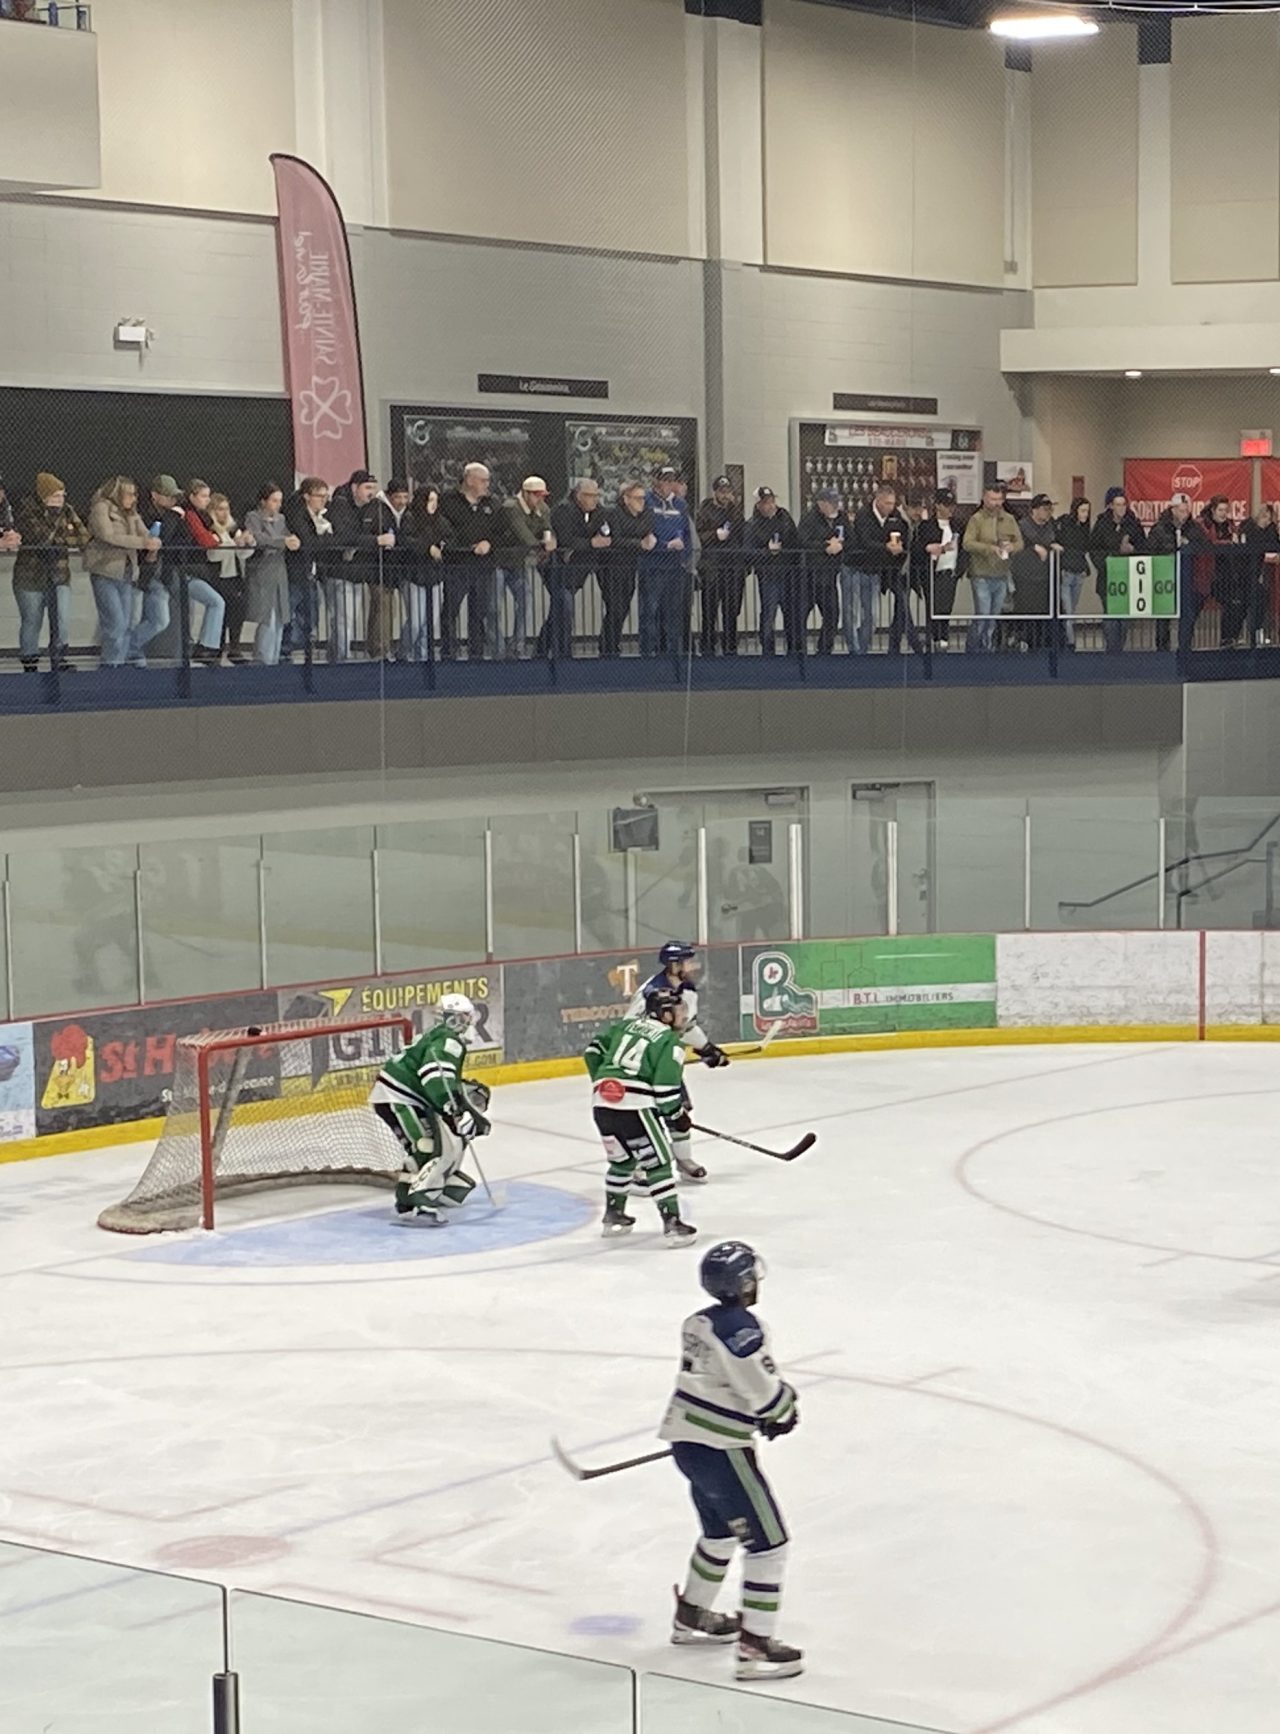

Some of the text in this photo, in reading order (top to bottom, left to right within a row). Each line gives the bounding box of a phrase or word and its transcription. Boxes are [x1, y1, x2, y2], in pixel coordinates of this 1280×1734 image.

[1174, 476, 1201, 489] STOP
[1107, 581, 1128, 597] GO
[1154, 579, 1175, 595] GO
[361, 977, 489, 1013] ÉQUIPEMENTS
[611, 1033, 651, 1077] 14
